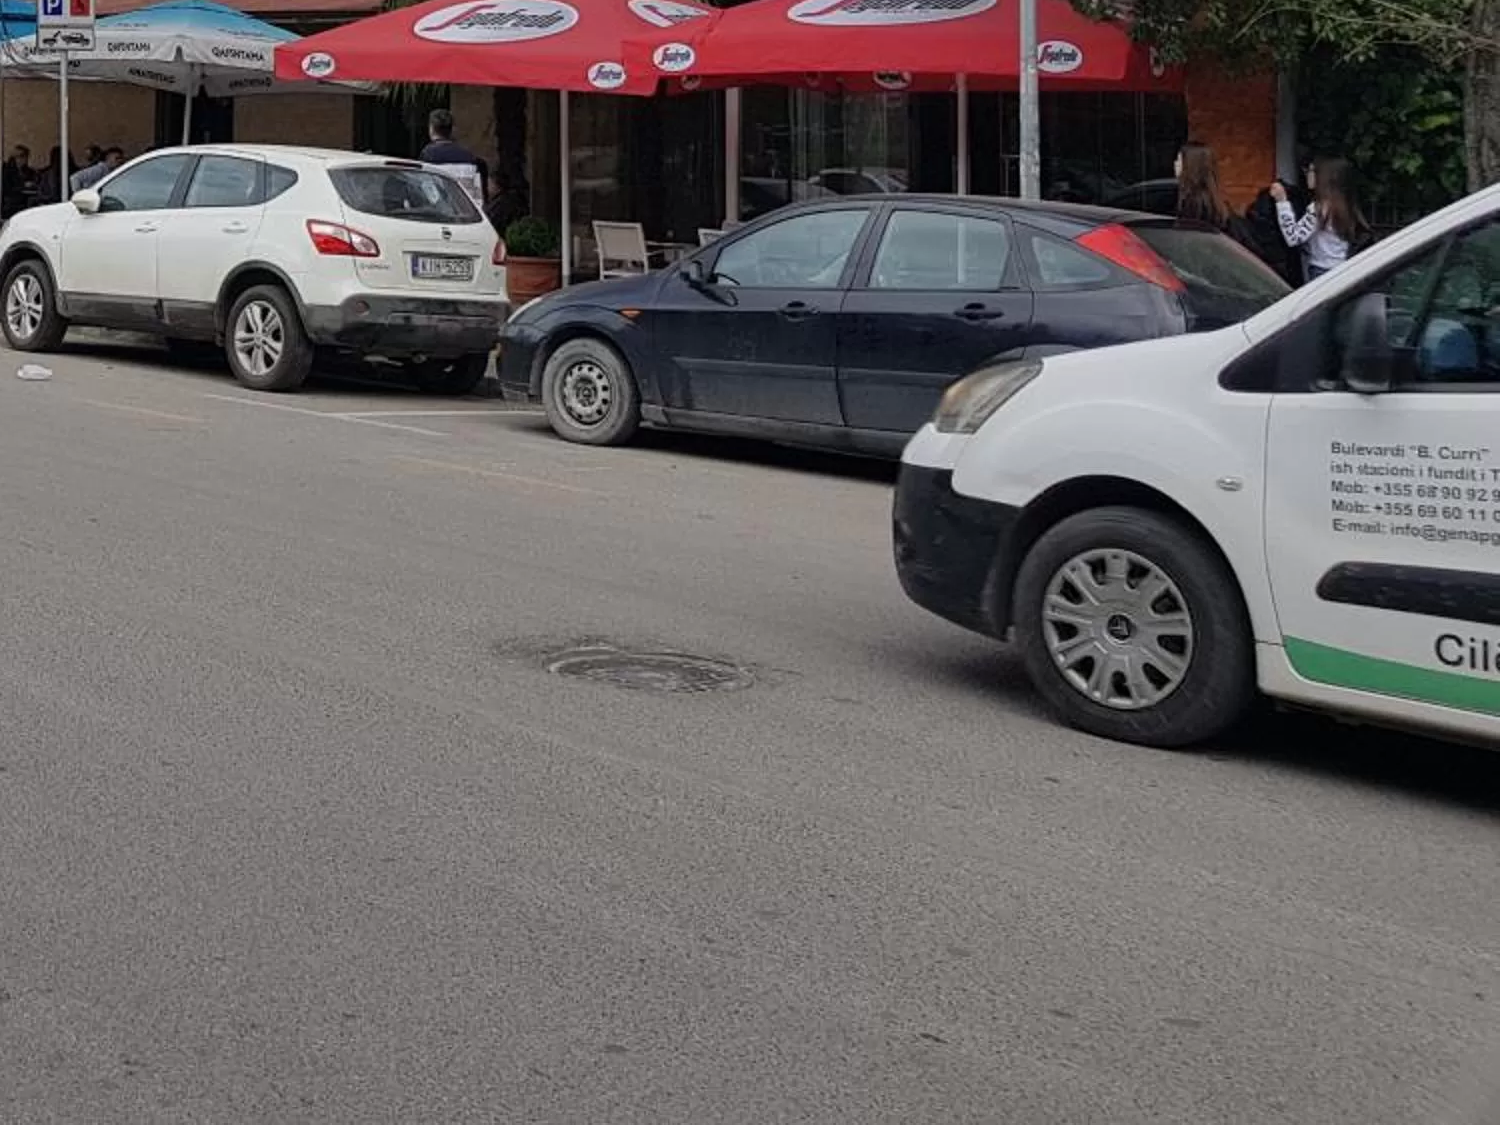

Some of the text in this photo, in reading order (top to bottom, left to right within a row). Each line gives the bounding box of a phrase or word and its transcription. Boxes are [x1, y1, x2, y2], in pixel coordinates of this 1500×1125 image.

[1331, 442, 1405, 457] Bulevardi
[1331, 461, 1353, 474] ish
[1357, 463, 1415, 476] stacioni
[1427, 466, 1477, 481] fundit
[1331, 480, 1369, 494] Mob:
[1374, 482, 1413, 497] +355
[1441, 486, 1461, 500] 90
[1466, 488, 1488, 502] 92
[1331, 499, 1371, 514] Mob:
[1374, 502, 1413, 516] +355
[1441, 506, 1462, 520] 60
[1466, 508, 1485, 521] 11
[1331, 518, 1387, 533] E-mail:
